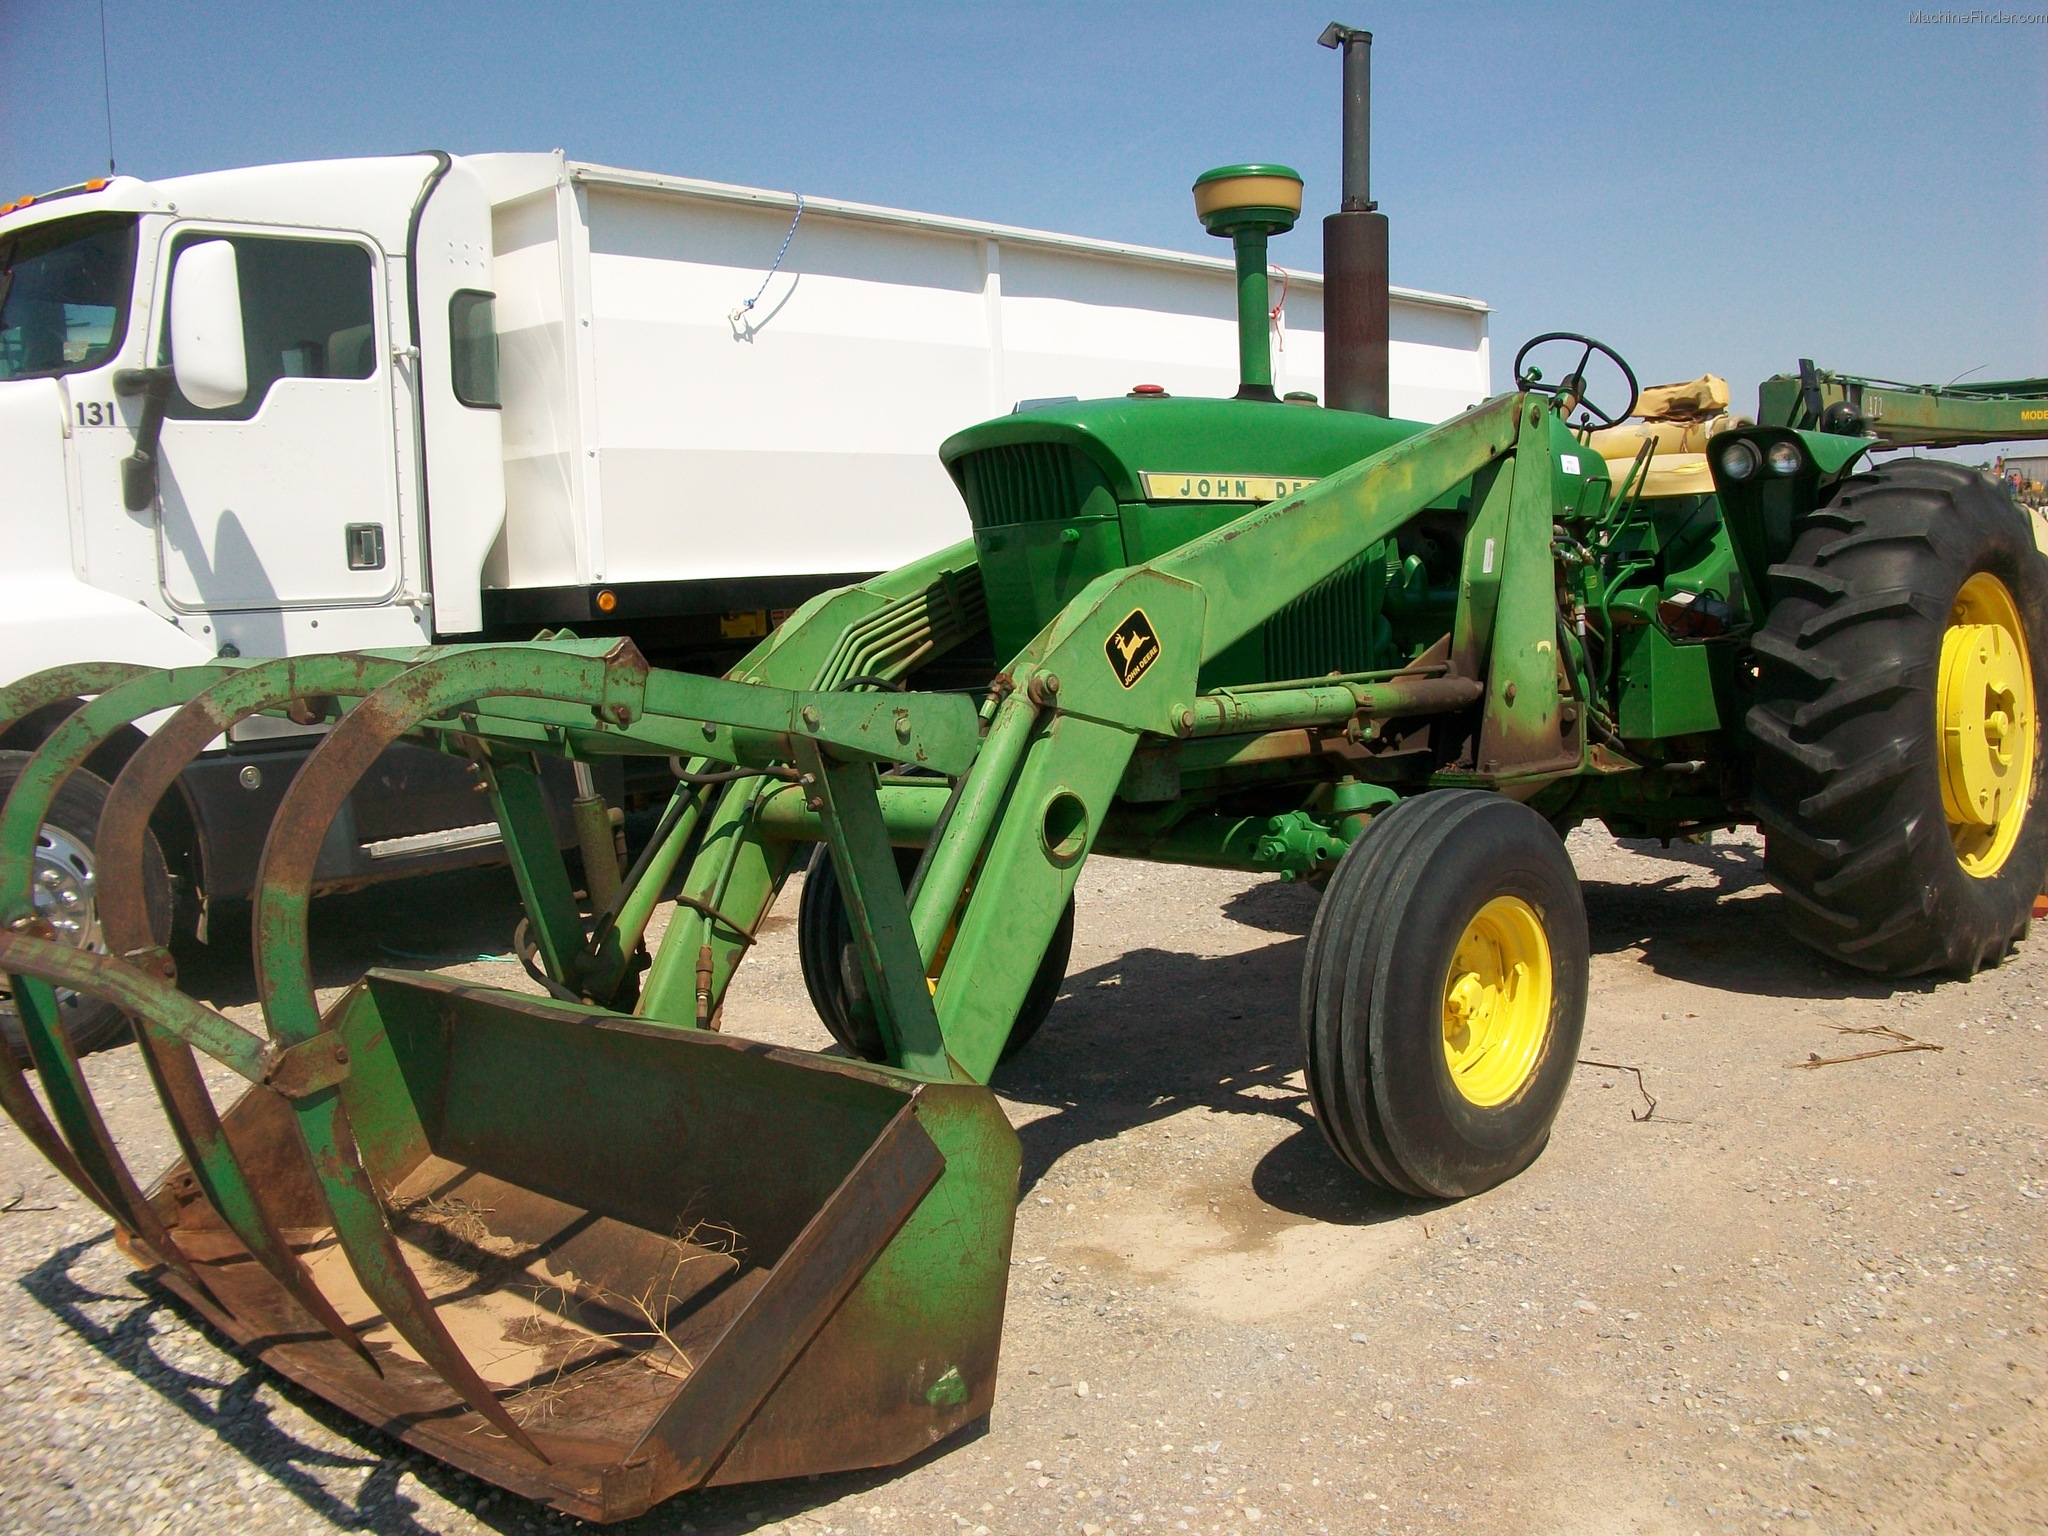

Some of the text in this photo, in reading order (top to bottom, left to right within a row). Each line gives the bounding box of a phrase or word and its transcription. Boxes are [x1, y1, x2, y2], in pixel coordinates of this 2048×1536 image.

[75, 401, 115, 426] 131
[1180, 478, 1314, 499] JOHN DE
[1124, 644, 1158, 686] JOHN DEERE
